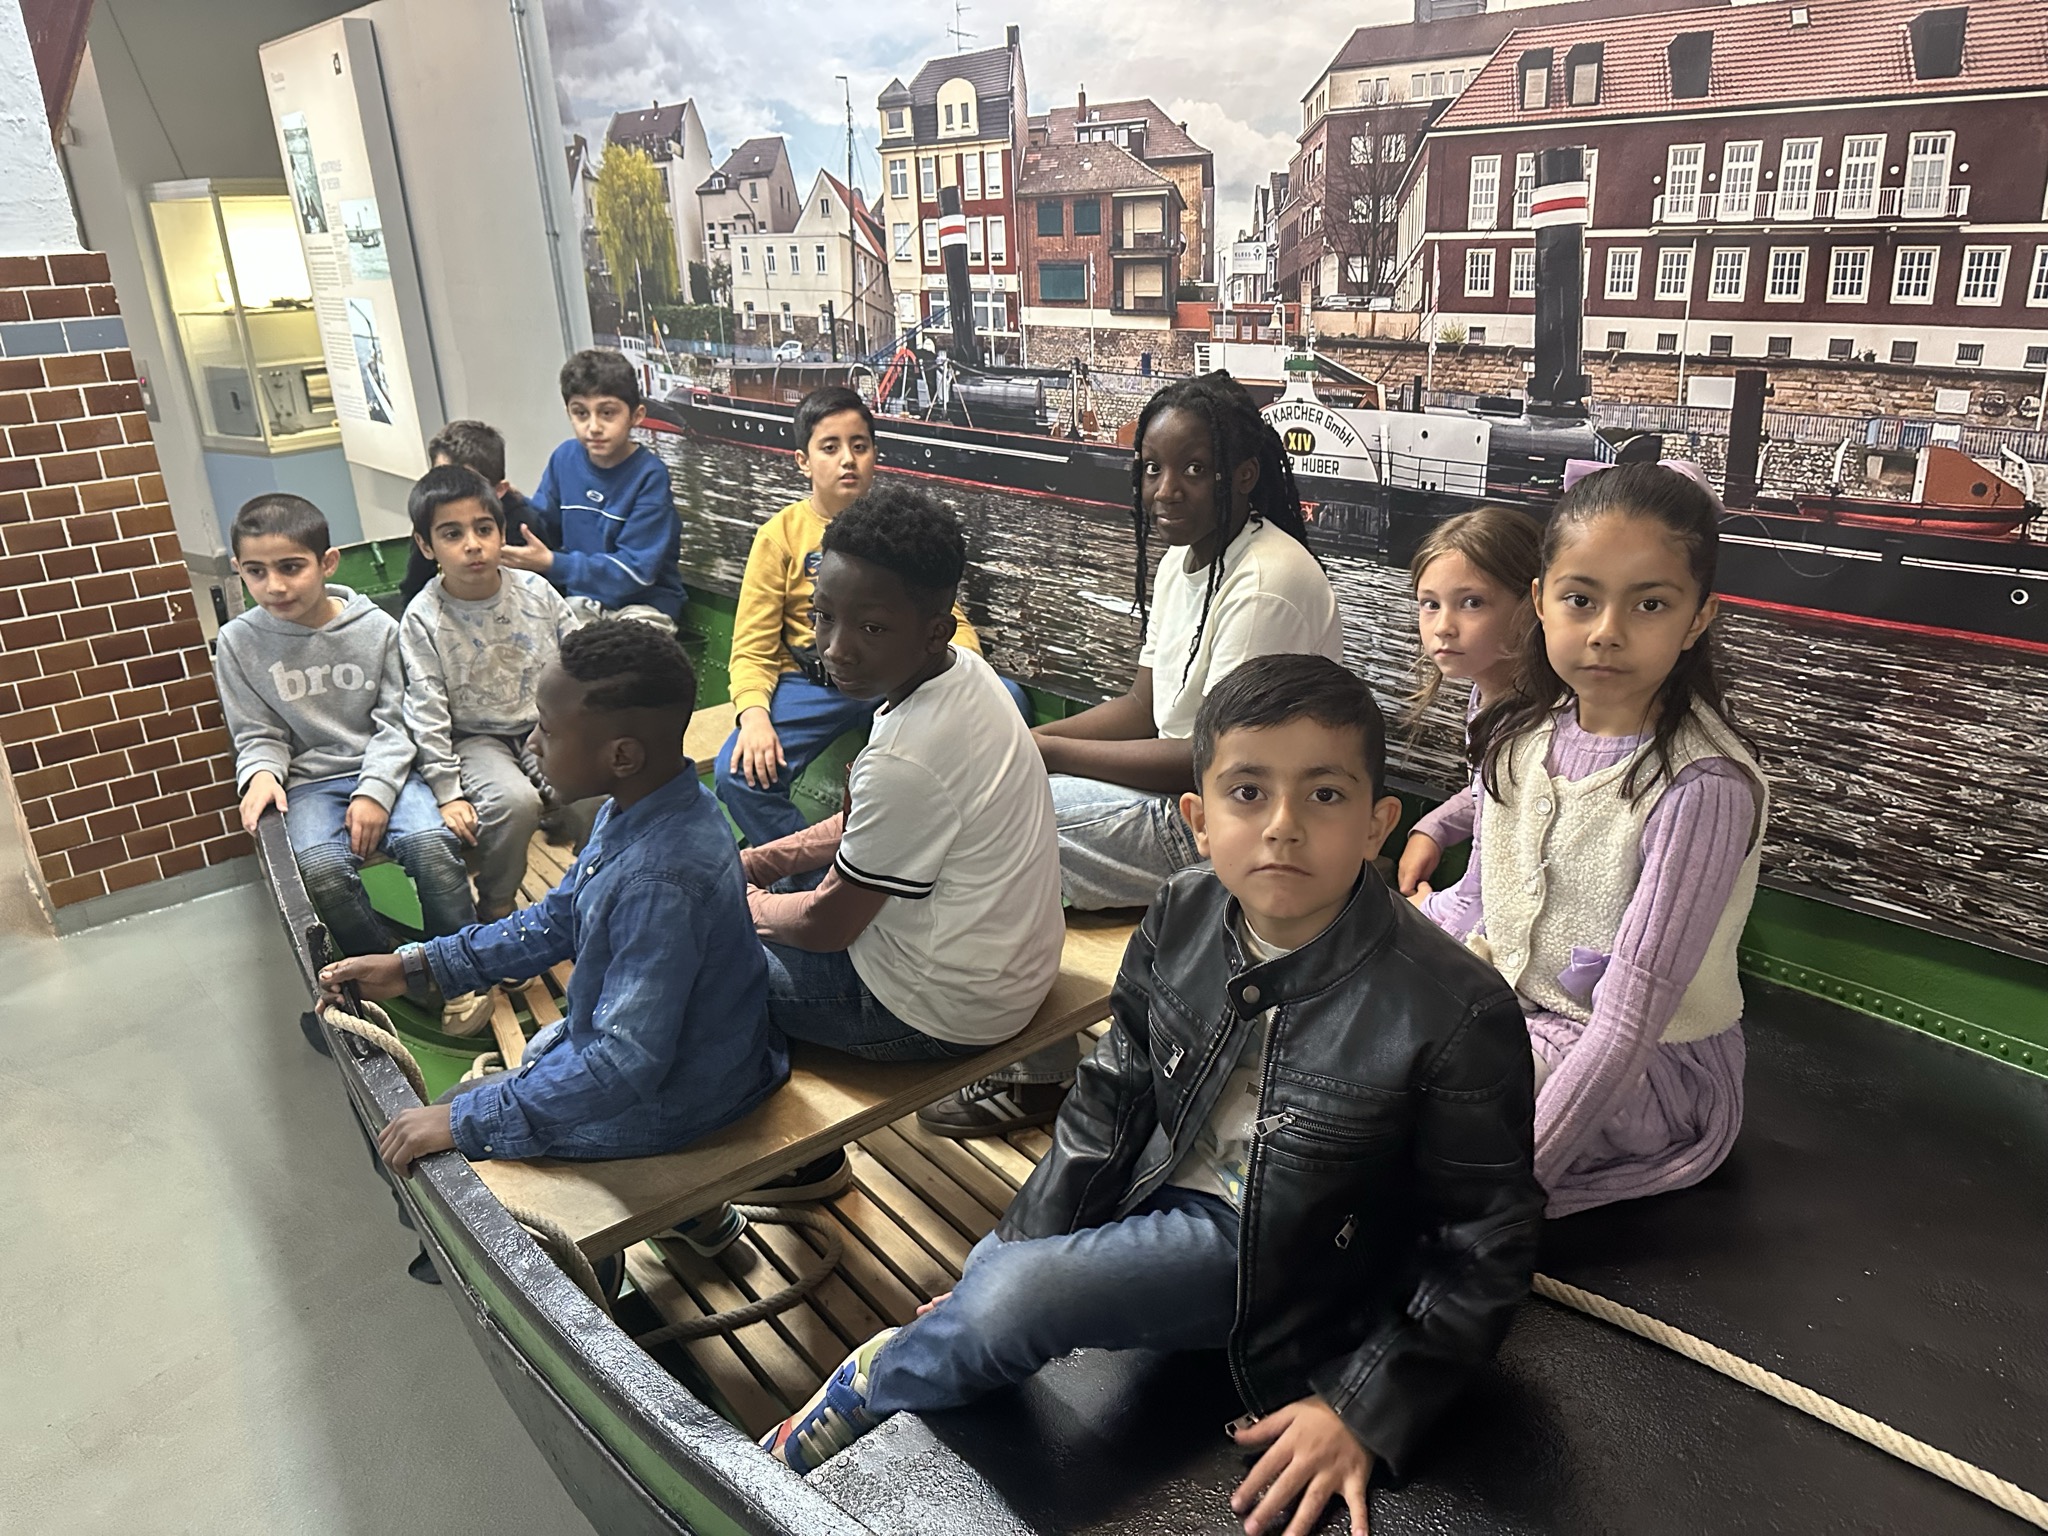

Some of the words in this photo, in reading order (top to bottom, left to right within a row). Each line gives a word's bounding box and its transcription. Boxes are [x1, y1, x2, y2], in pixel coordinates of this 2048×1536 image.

[1272, 405, 1324, 426] KARCHER
[1323, 414, 1355, 448] GmbH
[1287, 431, 1312, 452] XIV
[1301, 457, 1340, 476] HUBER
[268, 660, 376, 702] bro.
